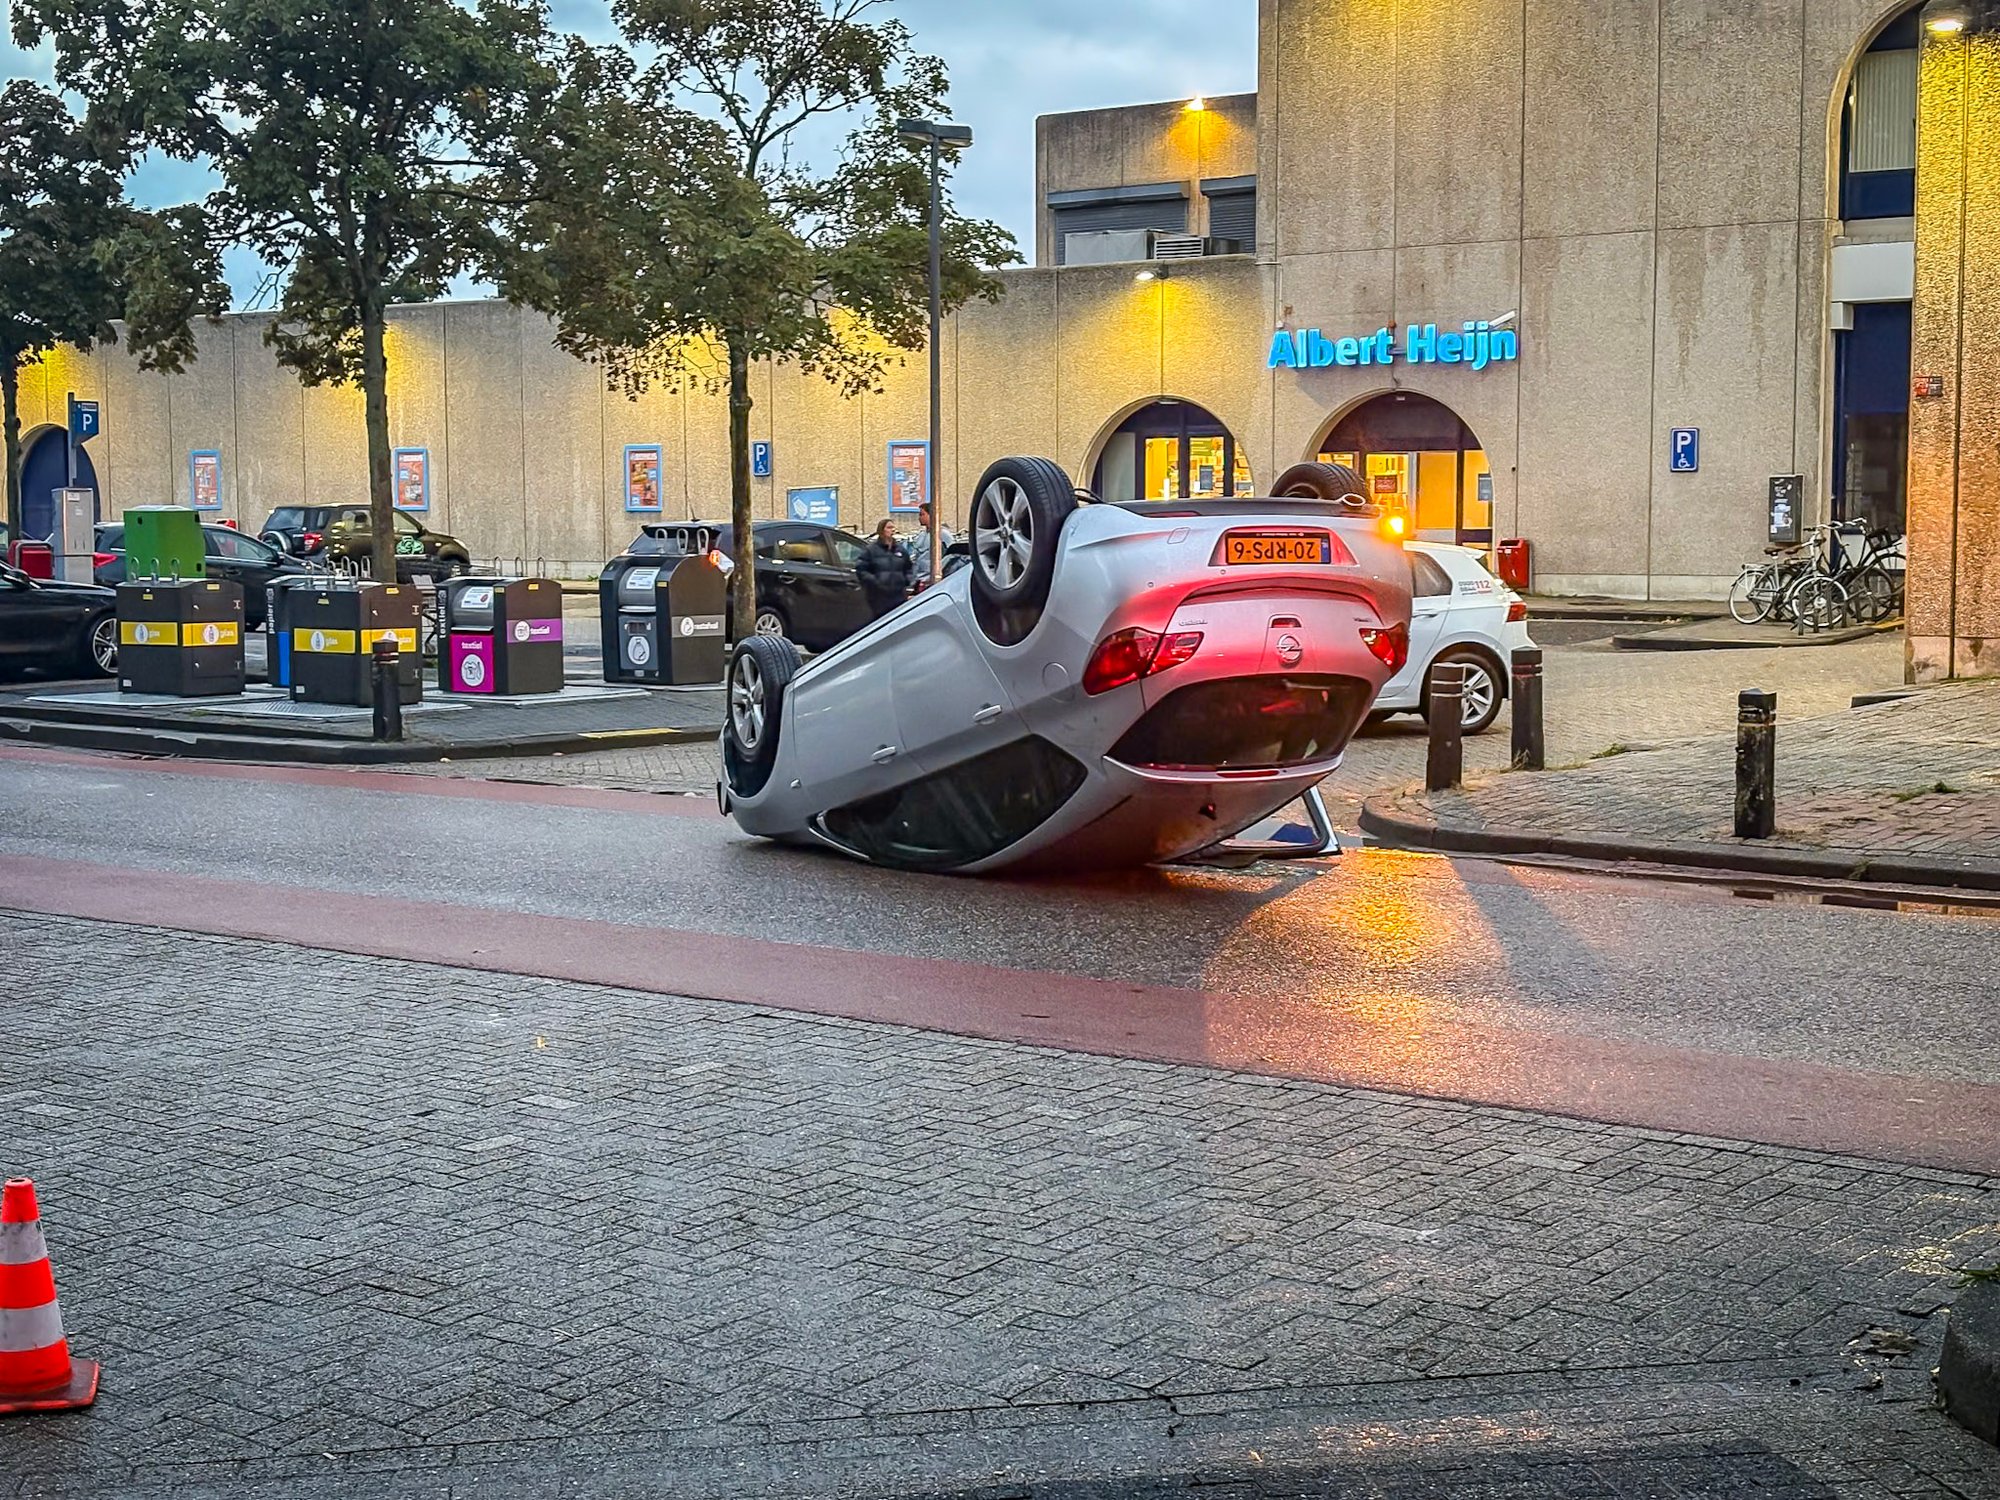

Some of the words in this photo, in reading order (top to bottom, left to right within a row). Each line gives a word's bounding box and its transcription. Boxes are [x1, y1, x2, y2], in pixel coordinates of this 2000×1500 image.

[1268, 327, 1394, 368] Albert
[1407, 321, 1517, 371] Heijn
[83, 414, 92, 431] P
[1677, 432, 1691, 453] P
[756, 445, 766, 461] P
[1234, 541, 1315, 560] 20-RPS-6
[1474, 580, 1490, 589] 112
[268, 604, 276, 635] papier
[439, 606, 447, 639] textiel
